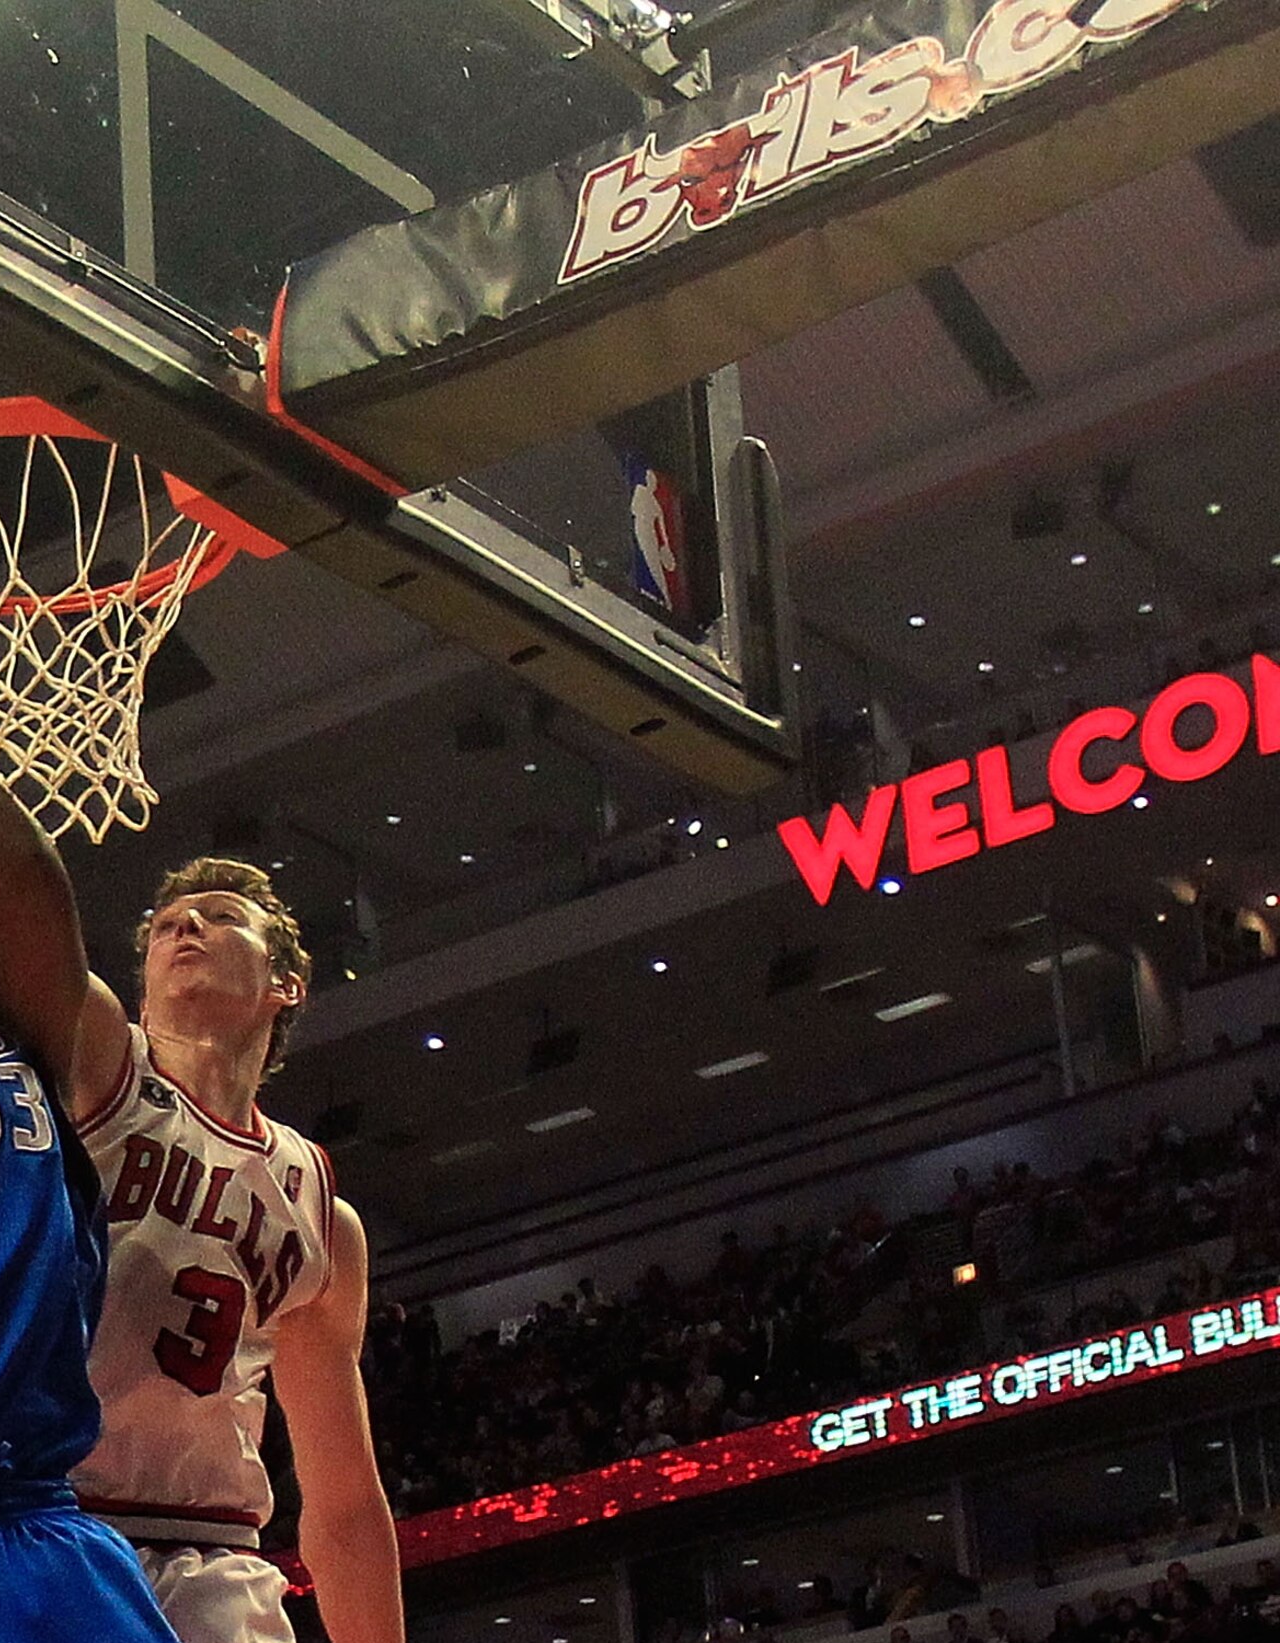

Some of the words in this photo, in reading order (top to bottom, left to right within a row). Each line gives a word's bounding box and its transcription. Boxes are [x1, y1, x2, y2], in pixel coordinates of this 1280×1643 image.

[776, 653, 1280, 906] WELCO
[107, 1133, 305, 1330] BULLS
[152, 1264, 246, 1397] 3
[810, 1398, 893, 1453] GET
[901, 1374, 985, 1429] THE
[992, 1324, 1185, 1405] OFFICIAL
[1190, 1293, 1280, 1356] BUL
